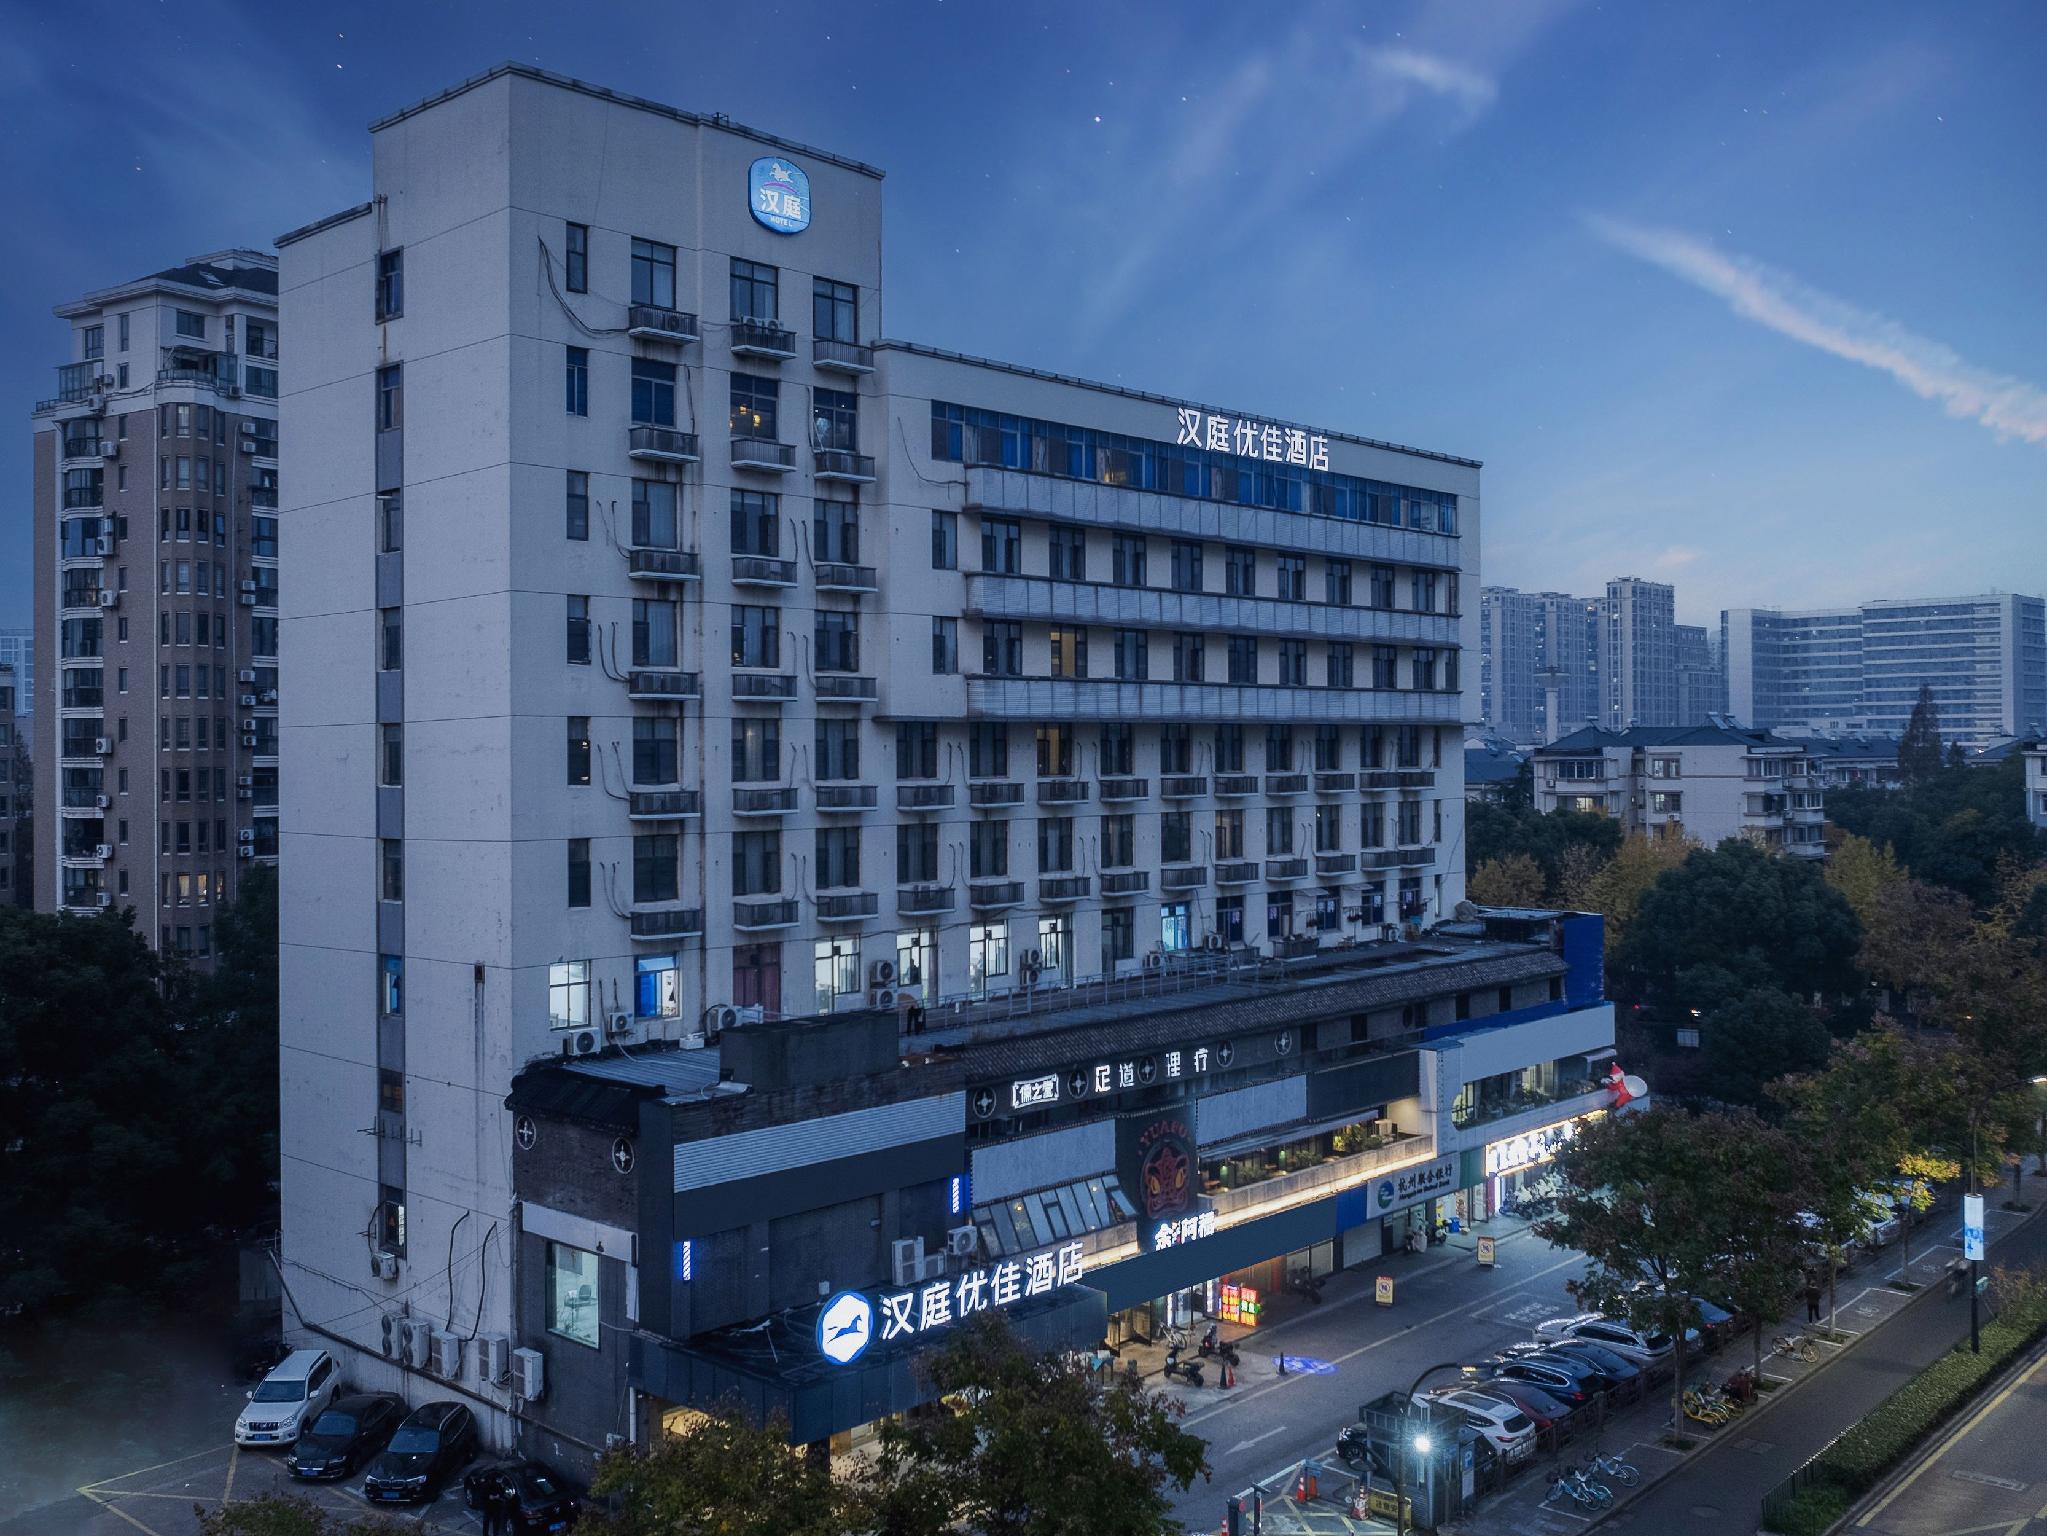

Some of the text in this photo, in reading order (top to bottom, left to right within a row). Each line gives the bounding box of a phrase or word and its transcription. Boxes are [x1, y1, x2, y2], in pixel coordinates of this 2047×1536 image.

[760, 188, 801, 220] 汉庭
[1176, 406, 1329, 472] 汉庭优佳酒店
[879, 1240, 1084, 1341] 汉庭优佳酒店
